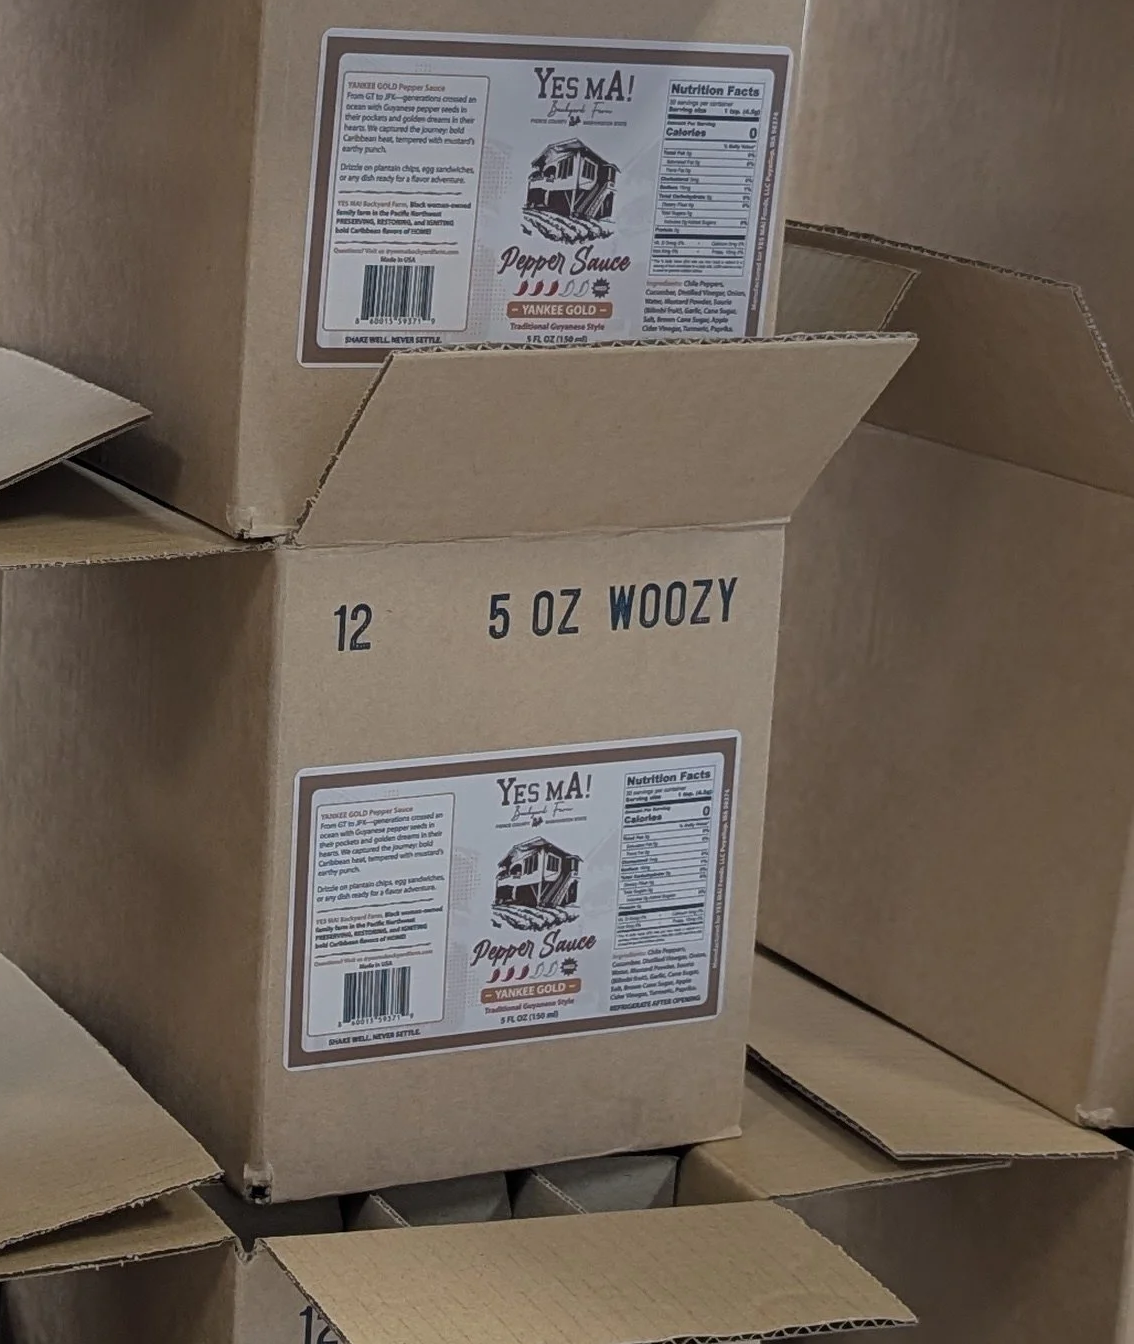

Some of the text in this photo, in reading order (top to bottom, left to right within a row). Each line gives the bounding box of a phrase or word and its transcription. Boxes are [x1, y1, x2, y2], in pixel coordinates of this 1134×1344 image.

[534, 67, 580, 99] YES
[670, 82, 759, 96] Nutrition Facts
[665, 126, 757, 139] Calories 0
[341, 145, 387, 155] earthy punch.
[497, 245, 566, 278] Pepper
[569, 244, 631, 276] Sauce
[522, 304, 596, 315] YANKEE GOLD
[333, 576, 738, 652] 12 5 OZ WOOZY
[626, 769, 711, 786] Nutrition Facts
[496, 776, 540, 806] YES
[469, 938, 535, 967] Pepper
[538, 928, 597, 959] Sauce
[495, 982, 566, 999] YANKEE GOLD
